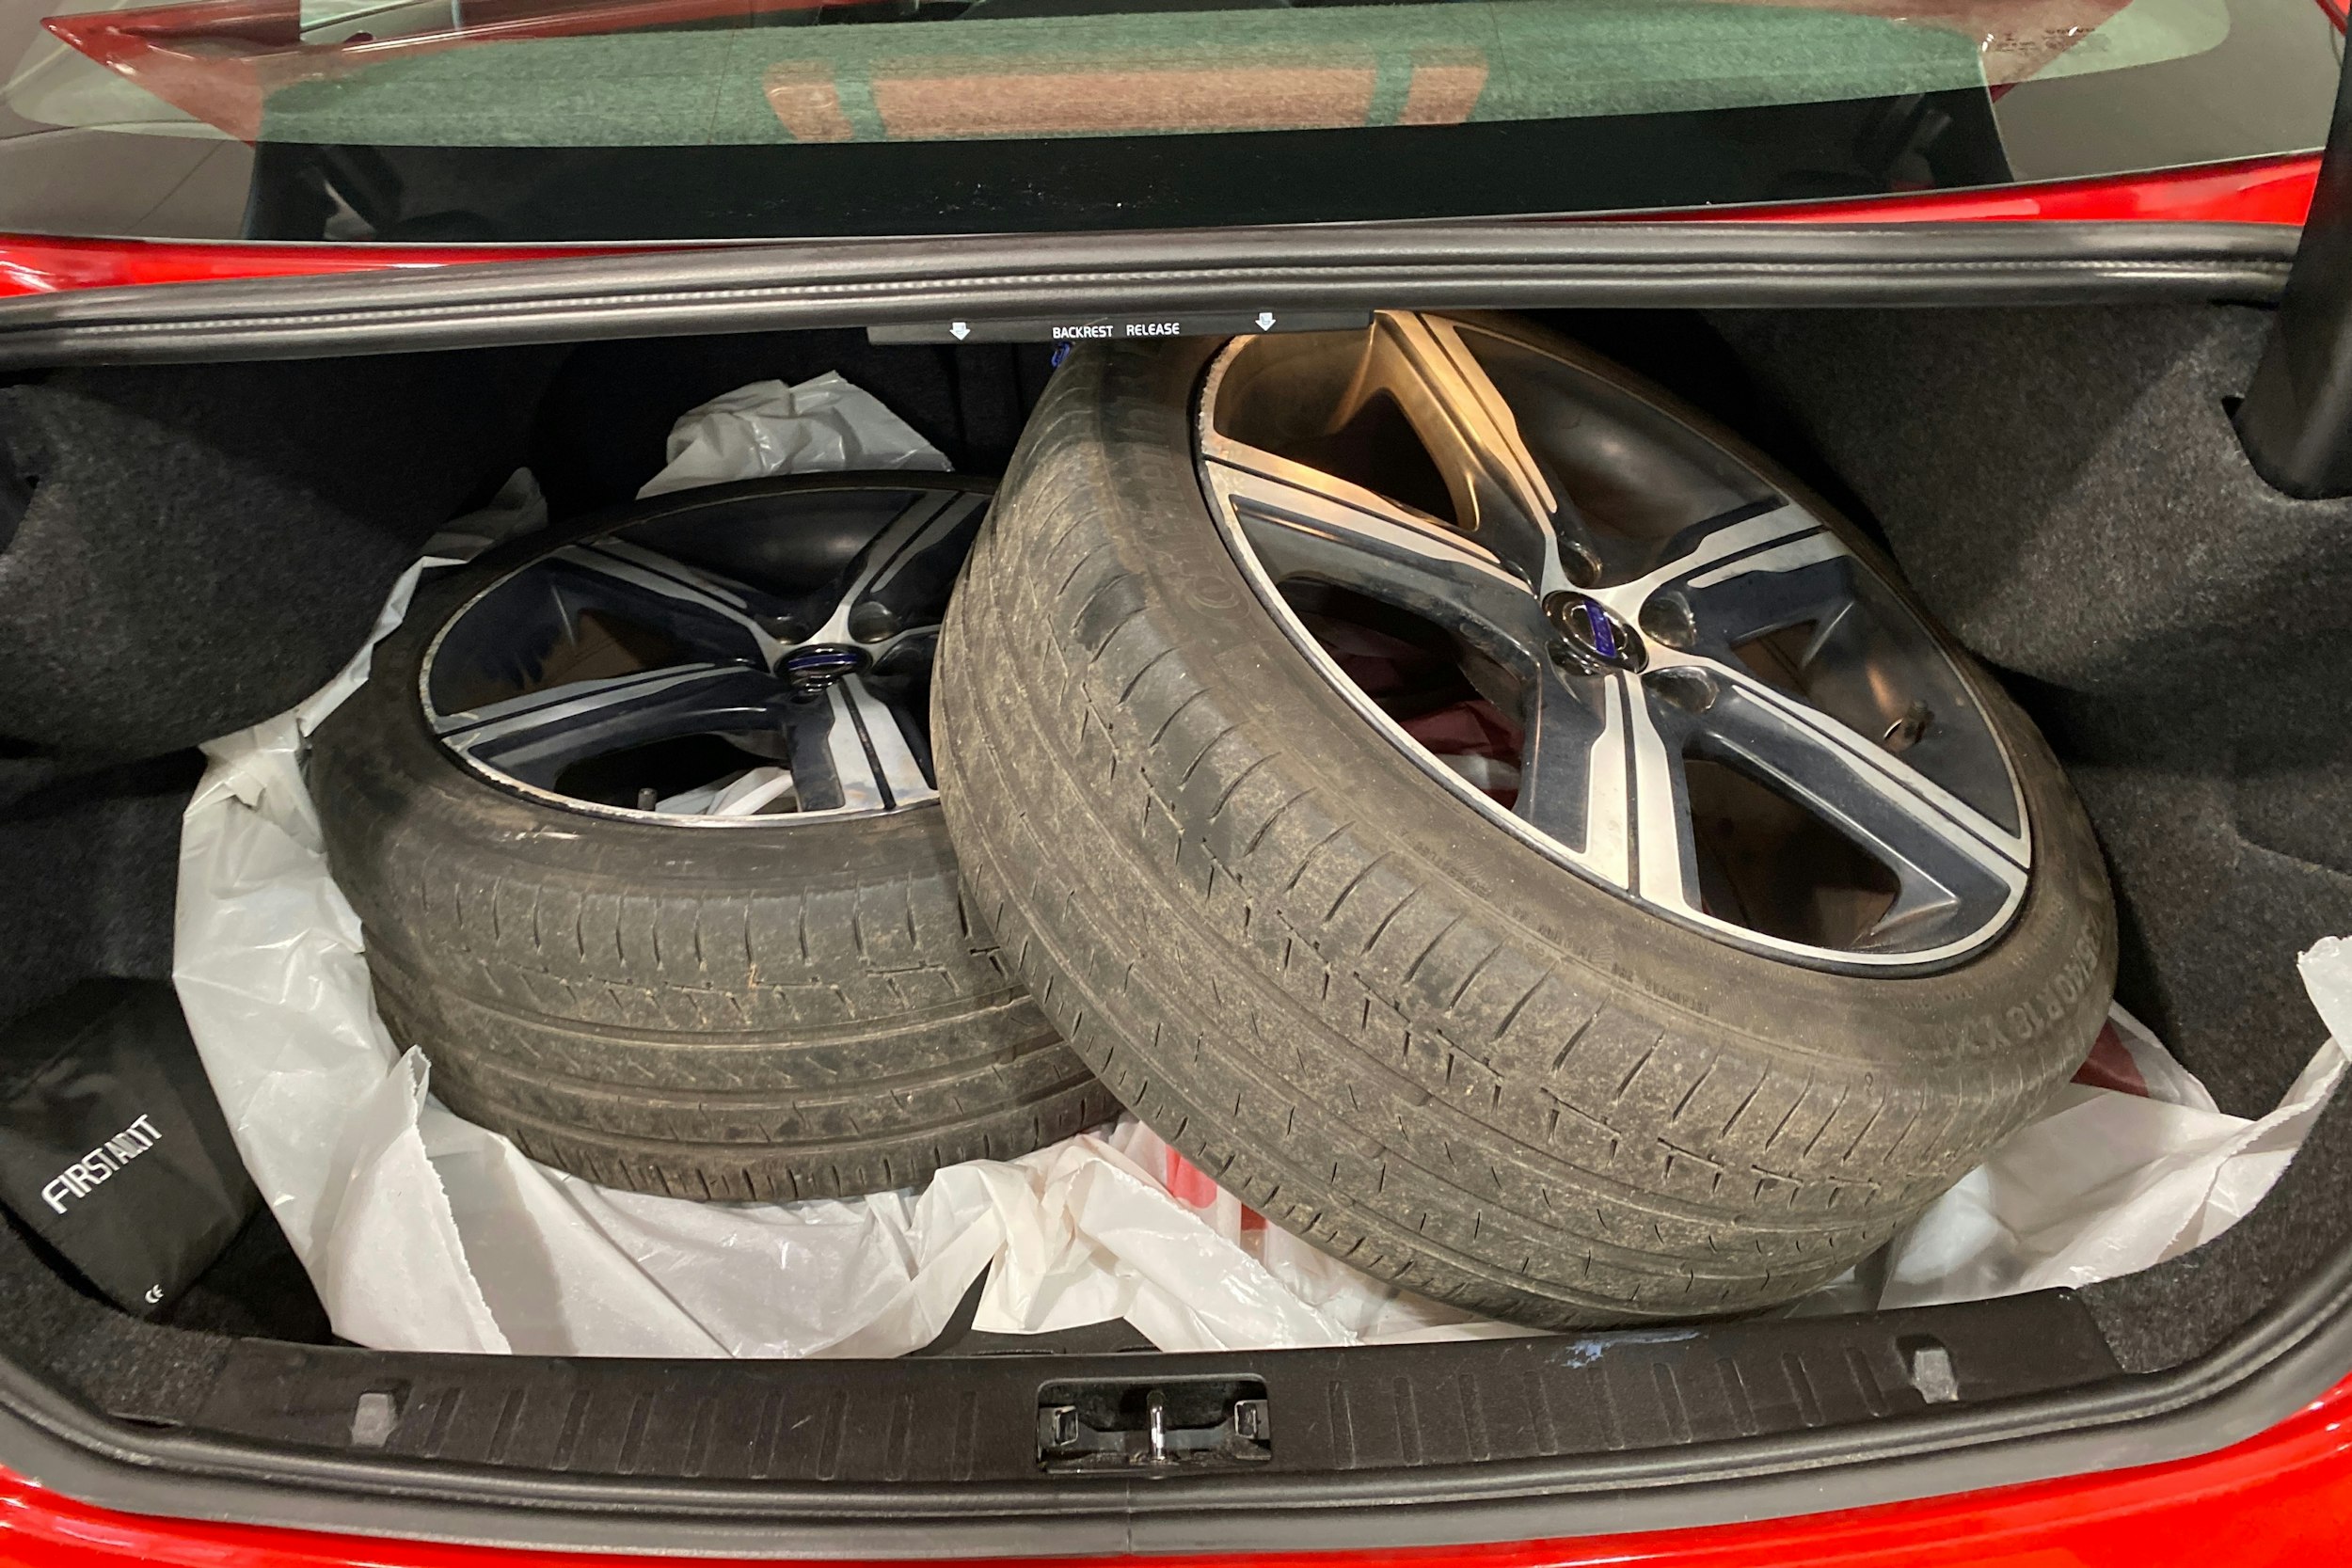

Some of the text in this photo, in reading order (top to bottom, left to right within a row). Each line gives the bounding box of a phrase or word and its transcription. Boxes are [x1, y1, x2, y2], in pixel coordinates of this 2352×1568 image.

[1052, 322, 1180, 339] BACKREST RELEASE
[41, 1147, 120, 1214] FIRST
